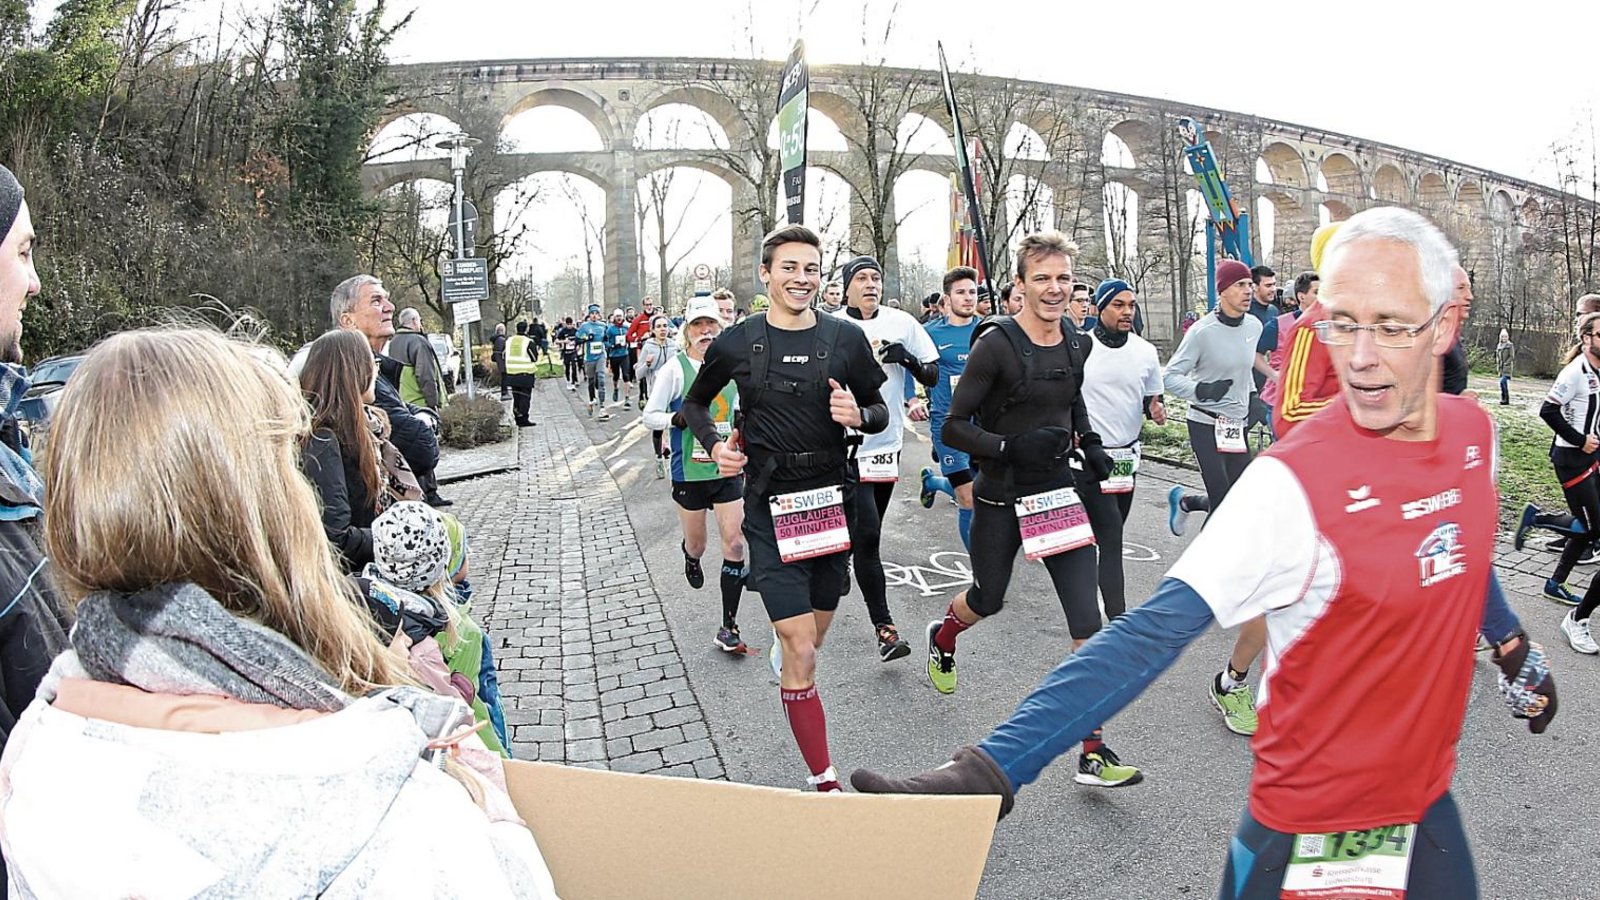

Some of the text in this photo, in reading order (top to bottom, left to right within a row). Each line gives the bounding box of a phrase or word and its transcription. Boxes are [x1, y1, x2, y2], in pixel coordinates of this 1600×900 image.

[1224, 427, 1240, 439] 329
[776, 505, 842, 527] ZUGLÄUFER
[1025, 516, 1084, 537] 50 MINUTEN
[780, 517, 842, 538] 50 MINUTEN
